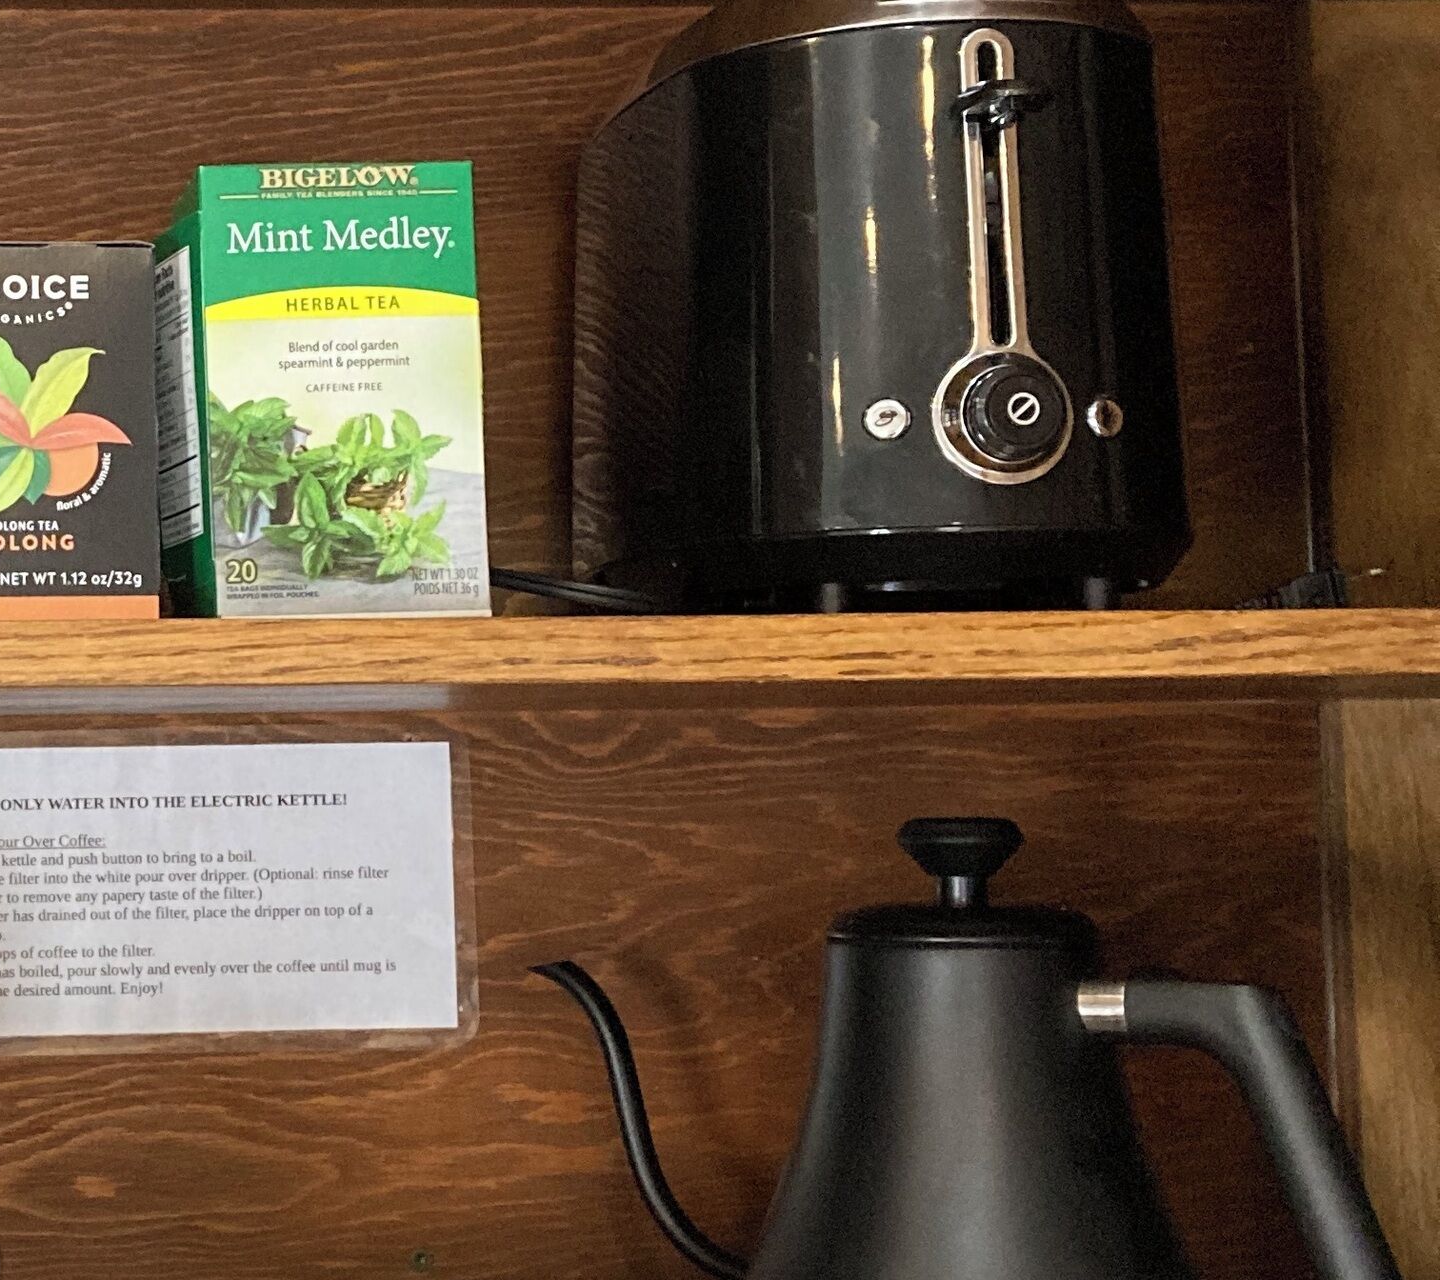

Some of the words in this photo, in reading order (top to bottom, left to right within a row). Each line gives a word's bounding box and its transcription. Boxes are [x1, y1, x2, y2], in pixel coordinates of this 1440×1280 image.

[226, 222, 314, 253] Mint
[287, 297, 360, 312] HERBAL
[366, 295, 400, 309] TEA
[289, 341, 320, 353] Blend
[322, 340, 333, 352] of
[336, 340, 358, 352] cool
[361, 339, 399, 354] garden
[279, 357, 333, 371] spearmint
[347, 355, 410, 370] peppermint
[306, 383, 355, 393] CAFFEINE
[358, 382, 382, 391] FREE
[56, 496, 83, 511] floral
[89, 452, 111, 496] aromatic
[38, 520, 59, 531] TEA
[0, 572, 30, 586] NET
[33, 572, 56, 586] WT
[60, 572, 87, 585] 1.12
[90, 570, 142, 588] oz/32g
[225, 558, 258, 584] 20
[0, 797, 44, 811] ONLY
[47, 796, 105, 810] WATER
[109, 795, 149, 809] INTO
[152, 795, 186, 809] THE
[190, 794, 273, 808] ELECTRIC
[277, 793, 348, 807] KETTLE!
[23, 835, 55, 848] Over
[59, 833, 106, 849] Coffee:
[1, 854, 37, 866] kettle
[41, 853, 64, 865] and
[68, 853, 98, 869] push
[102, 852, 142, 865] button
[163, 851, 197, 867] bring
[228, 850, 257, 862] boil.
[8, 871, 40, 884] filter
[44, 871, 69, 883] into
[73, 871, 92, 883] the
[96, 870, 132, 883] white
[135, 872, 164, 887] pour
[168, 872, 197, 882] over
[201, 869, 248, 885] dripper.
[253, 868, 316, 884] (Optional:
[323, 868, 354, 880] rinse
[358, 866, 390, 879] filter
[23, 892, 71, 903] remove
[75, 892, 99, 906] any
[103, 890, 145, 906] papery
[149, 889, 179, 902] taste
[182, 888, 196, 901] of
[199, 887, 220, 900] the
[223, 886, 263, 901] filter.)
[13, 909, 34, 922] has
[38, 908, 86, 921] drained
[90, 909, 110, 920] out
[115, 908, 129, 921] of
[132, 907, 151, 920] the
[155, 906, 190, 921] filter,
[194, 906, 228, 921] place
[231, 905, 250, 918] the
[254, 904, 301, 920] dripper
[305, 906, 321, 916] on
[324, 905, 345, 919] top
[348, 903, 362, 917] of
[20, 946, 35, 959] of
[38, 946, 78, 959] coffee
[97, 945, 118, 957] the
[121, 944, 156, 957] filter.
[19, 965, 63, 980] boiled,
[67, 966, 97, 980] pour
[101, 963, 142, 978] slowly
[146, 962, 170, 975] and
[174, 962, 216, 978] evenly
[220, 963, 248, 974] over
[253, 960, 273, 973] the
[276, 959, 316, 973] coffee
[320, 959, 349, 972] until
[353, 961, 382, 975] mug
[386, 959, 397, 972] is
[14, 981, 60, 995] desired
[64, 981, 116, 994] amount.
[120, 980, 163, 997] Enjoy!
